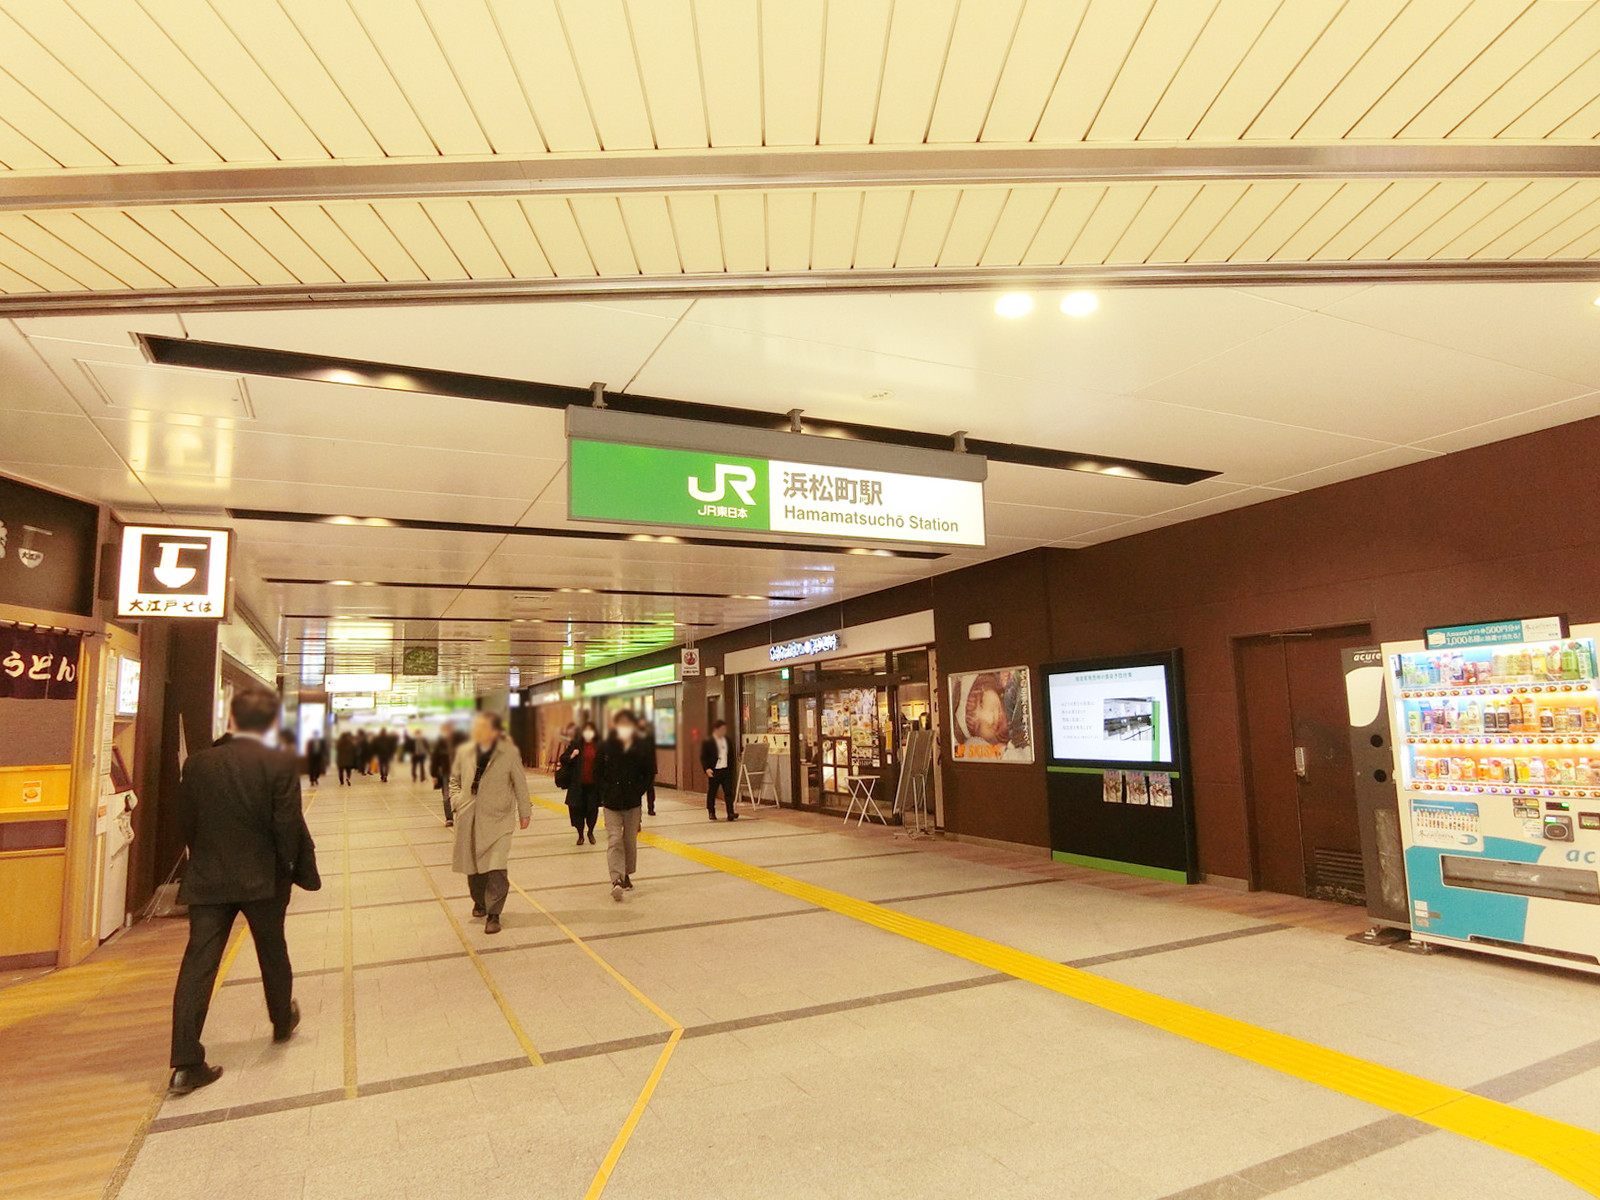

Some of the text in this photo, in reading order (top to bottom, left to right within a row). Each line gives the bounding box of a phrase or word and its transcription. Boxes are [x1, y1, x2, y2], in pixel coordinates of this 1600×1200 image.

[688, 463, 757, 506] JR
[783, 471, 883, 507] 浜松町駅
[697, 505, 748, 520] JR東日本
[784, 505, 959, 533] Hamamatsuchō Station
[2, 650, 76, 682] うどん
[1353, 653, 1382, 662] acure
